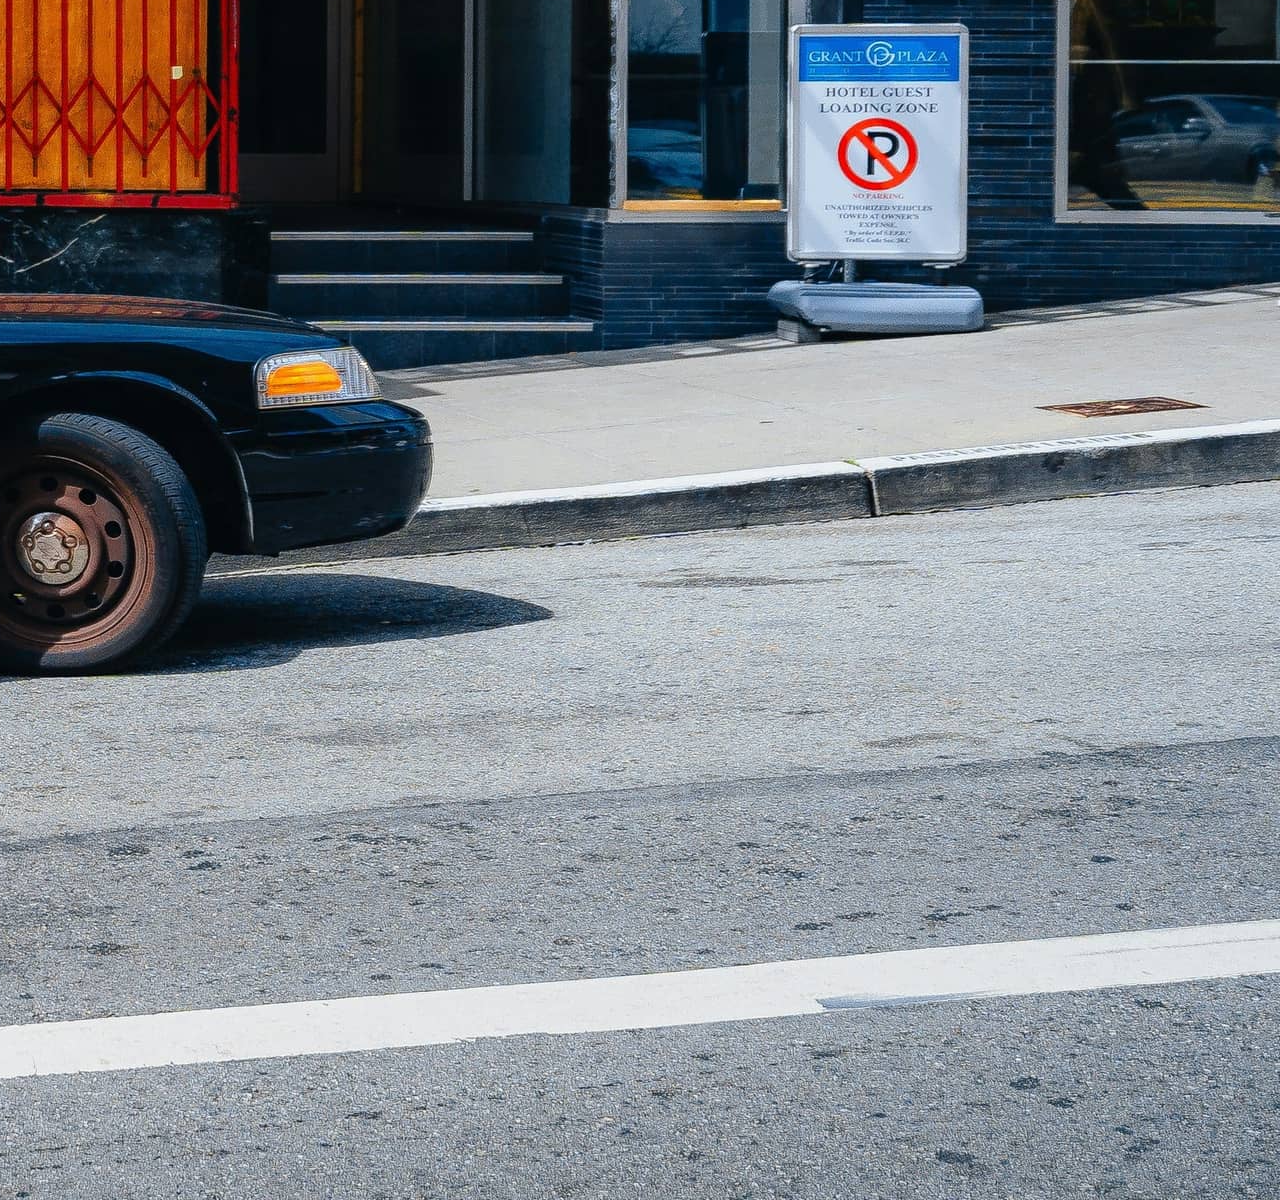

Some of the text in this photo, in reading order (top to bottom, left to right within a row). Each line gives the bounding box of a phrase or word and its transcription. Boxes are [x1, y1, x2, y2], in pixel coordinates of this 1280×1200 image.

[809, 51, 864, 62] GRANT
[898, 51, 948, 62] PLAZA
[826, 87, 933, 98] HOTEL GUEST
[820, 103, 939, 114] LOADING ZONE
[852, 192, 904, 200] NO PARKING
[891, 204, 933, 212] VEHICLES
